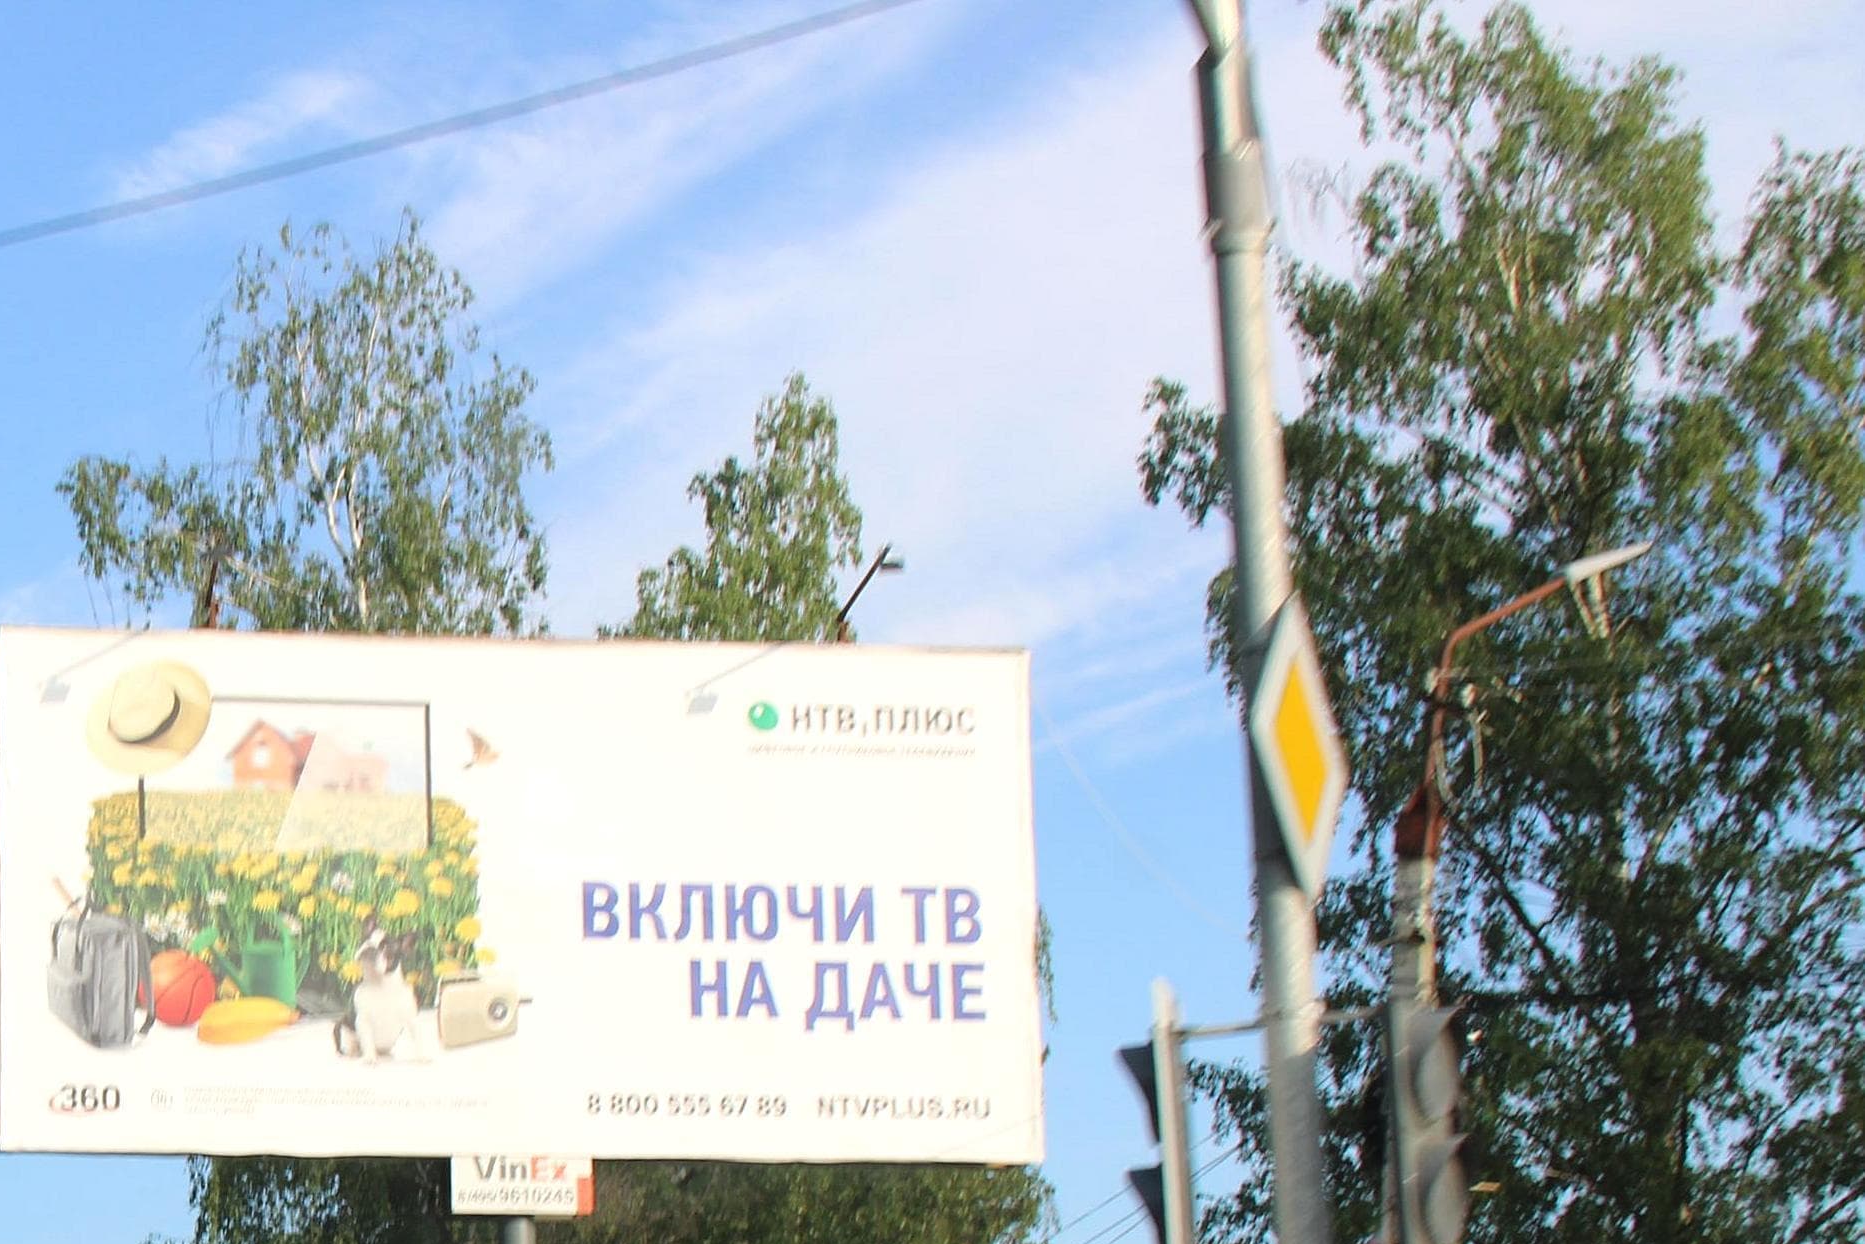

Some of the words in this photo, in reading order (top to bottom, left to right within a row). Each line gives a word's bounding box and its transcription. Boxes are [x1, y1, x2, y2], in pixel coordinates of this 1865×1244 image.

[581, 882, 876, 943] ВКЛЮЧИ
[900, 886, 983, 944] ТВ
[689, 959, 780, 1018] НА
[804, 961, 987, 1031] ДАЧЕ
[588, 1093, 601, 1116] 8
[610, 1093, 659, 1116] 800
[669, 1094, 711, 1117] 555
[720, 1095, 748, 1117] 67
[758, 1096, 786, 1118] 89
[818, 1096, 992, 1120] NTVPLUS.RU
[473, 1155, 567, 1180] VinEx
